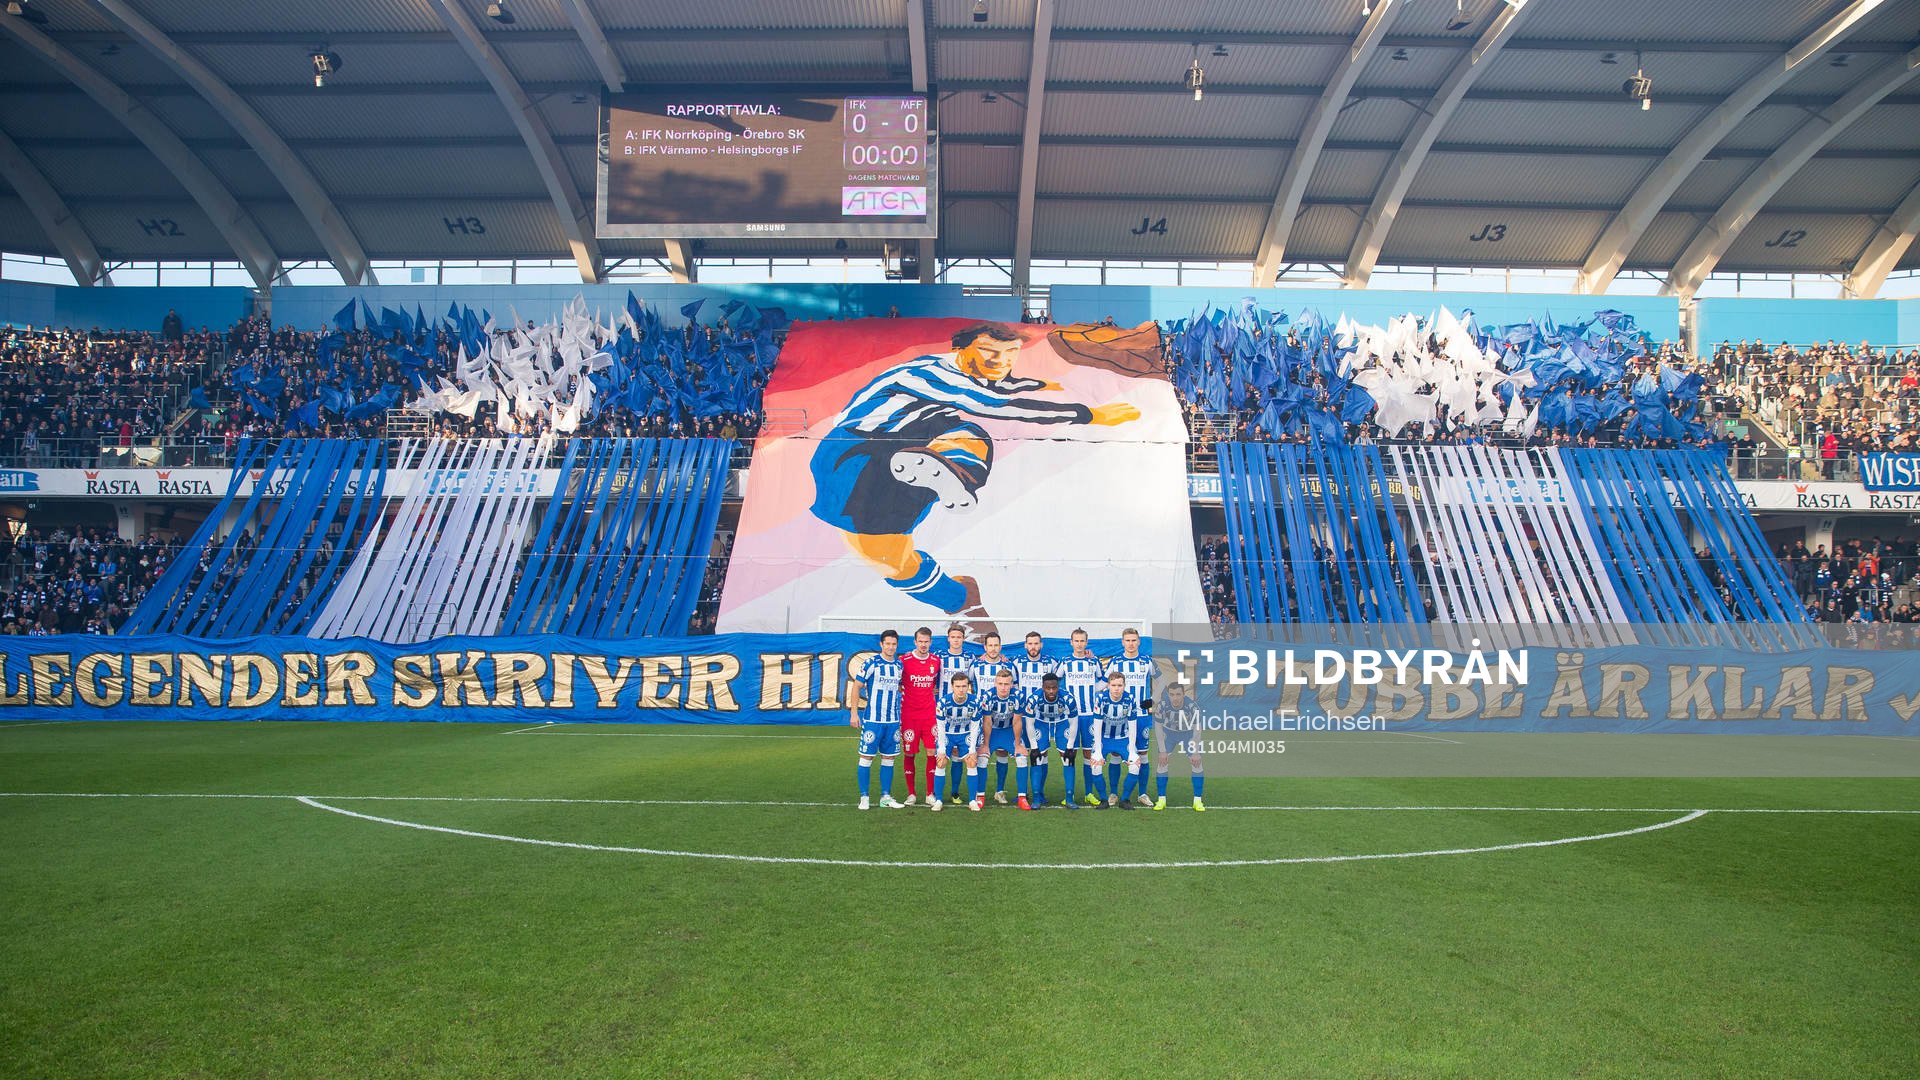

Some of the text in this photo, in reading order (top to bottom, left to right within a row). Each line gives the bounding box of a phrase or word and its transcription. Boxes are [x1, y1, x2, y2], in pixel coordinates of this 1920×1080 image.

[666, 104, 781, 115] RAPPORTTAVLA:
[849, 100, 867, 109] IFK
[901, 100, 923, 109] MFF
[852, 113, 866, 133] 0
[904, 113, 918, 133] 0
[625, 130, 638, 139] A:
[642, 130, 662, 139] IFK
[665, 130, 732, 141] Norrköping
[743, 128, 785, 139] Örebro
[788, 129, 805, 139] SK
[624, 146, 636, 155] B:
[639, 146, 657, 155] IFK
[660, 145, 708, 155] Värnamo
[718, 145, 789, 157] Helsingborgs
[792, 145, 802, 154] IF
[846, 191, 920, 210] ATEA
[137, 218, 185, 237] H2
[443, 217, 485, 235] H3
[746, 223, 786, 231] SAMSUNG
[1131, 217, 1168, 236] J4
[1469, 224, 1508, 242] J3
[1765, 229, 1807, 247] J2
[86, 480, 142, 494] RASTA
[158, 480, 213, 494] RASTA
[1797, 494, 1852, 508] RASTA
[0, 650, 377, 708] LEGENDER
[392, 649, 742, 711] SKRIVER
[1540, 651, 1651, 720] ÄR
[1665, 663, 1876, 721] KLAR
